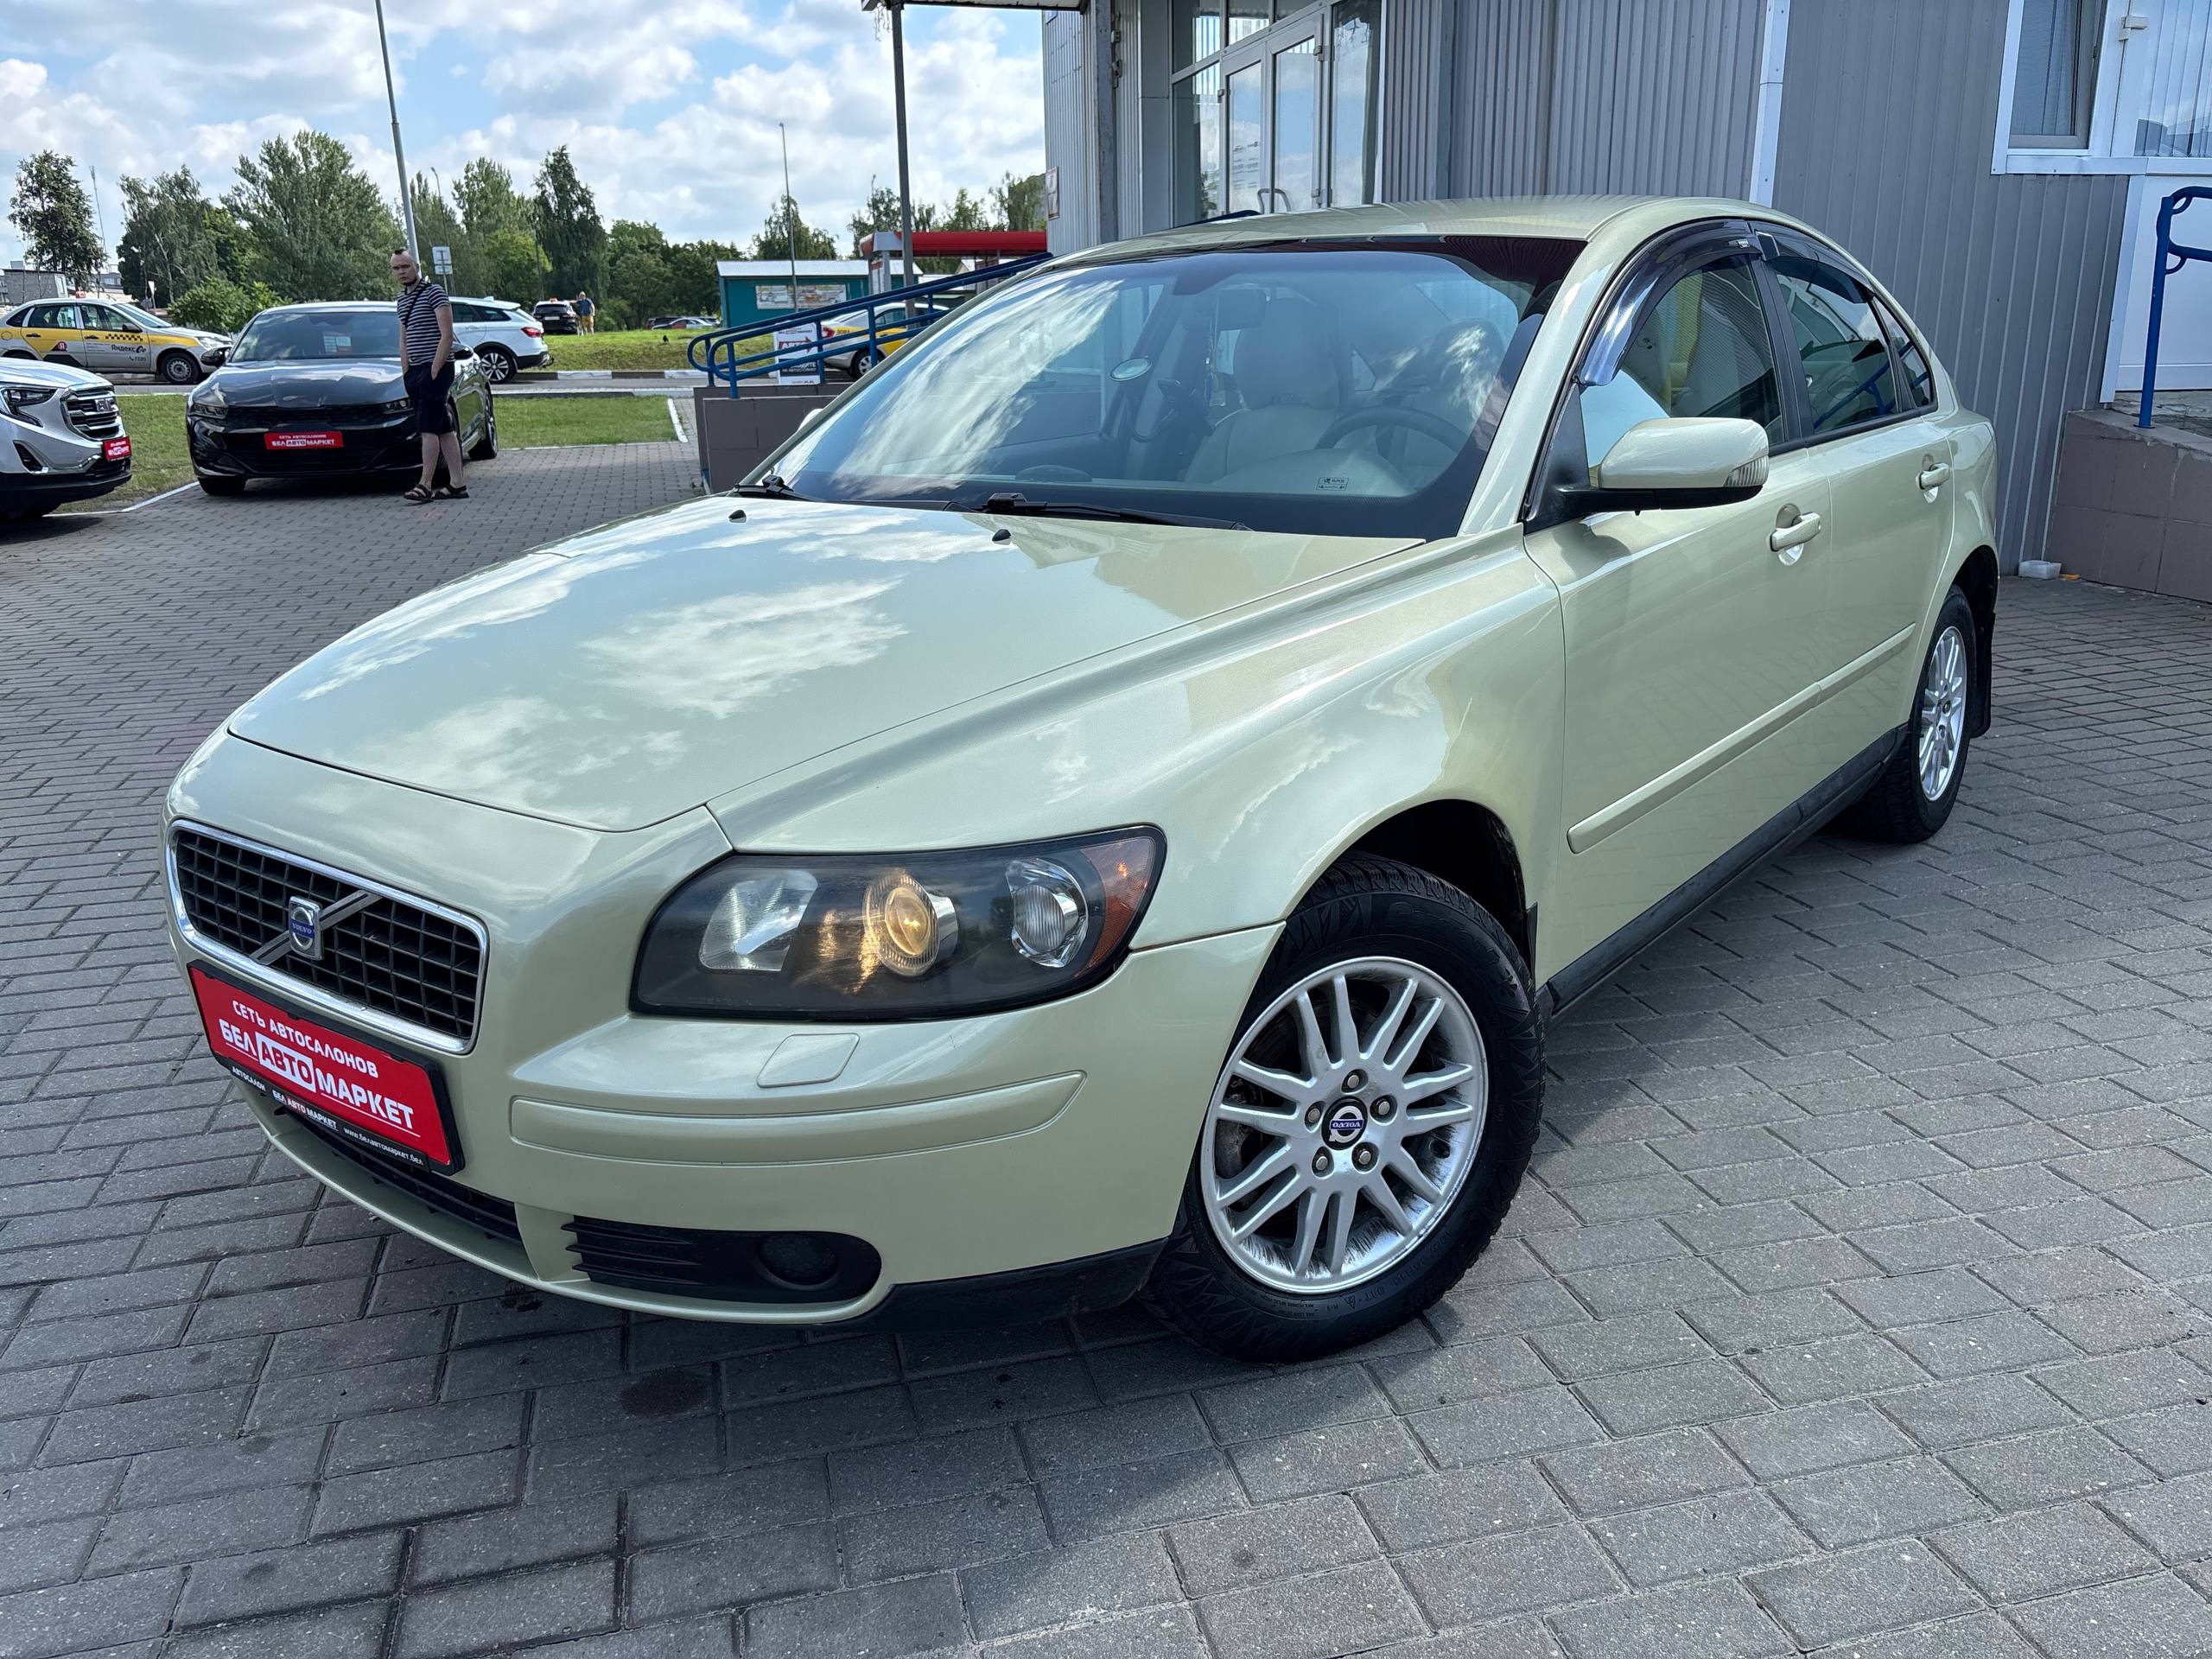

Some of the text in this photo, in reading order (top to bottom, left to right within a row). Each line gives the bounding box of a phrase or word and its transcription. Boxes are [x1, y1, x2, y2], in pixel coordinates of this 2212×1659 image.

[292, 922, 312, 934] VOLVO
[232, 1000, 378, 1078] СЕТЬ АВТОСАЛОНОВ
[271, 1089, 338, 1129] БЕЛ АВТО МАРКЕТ
